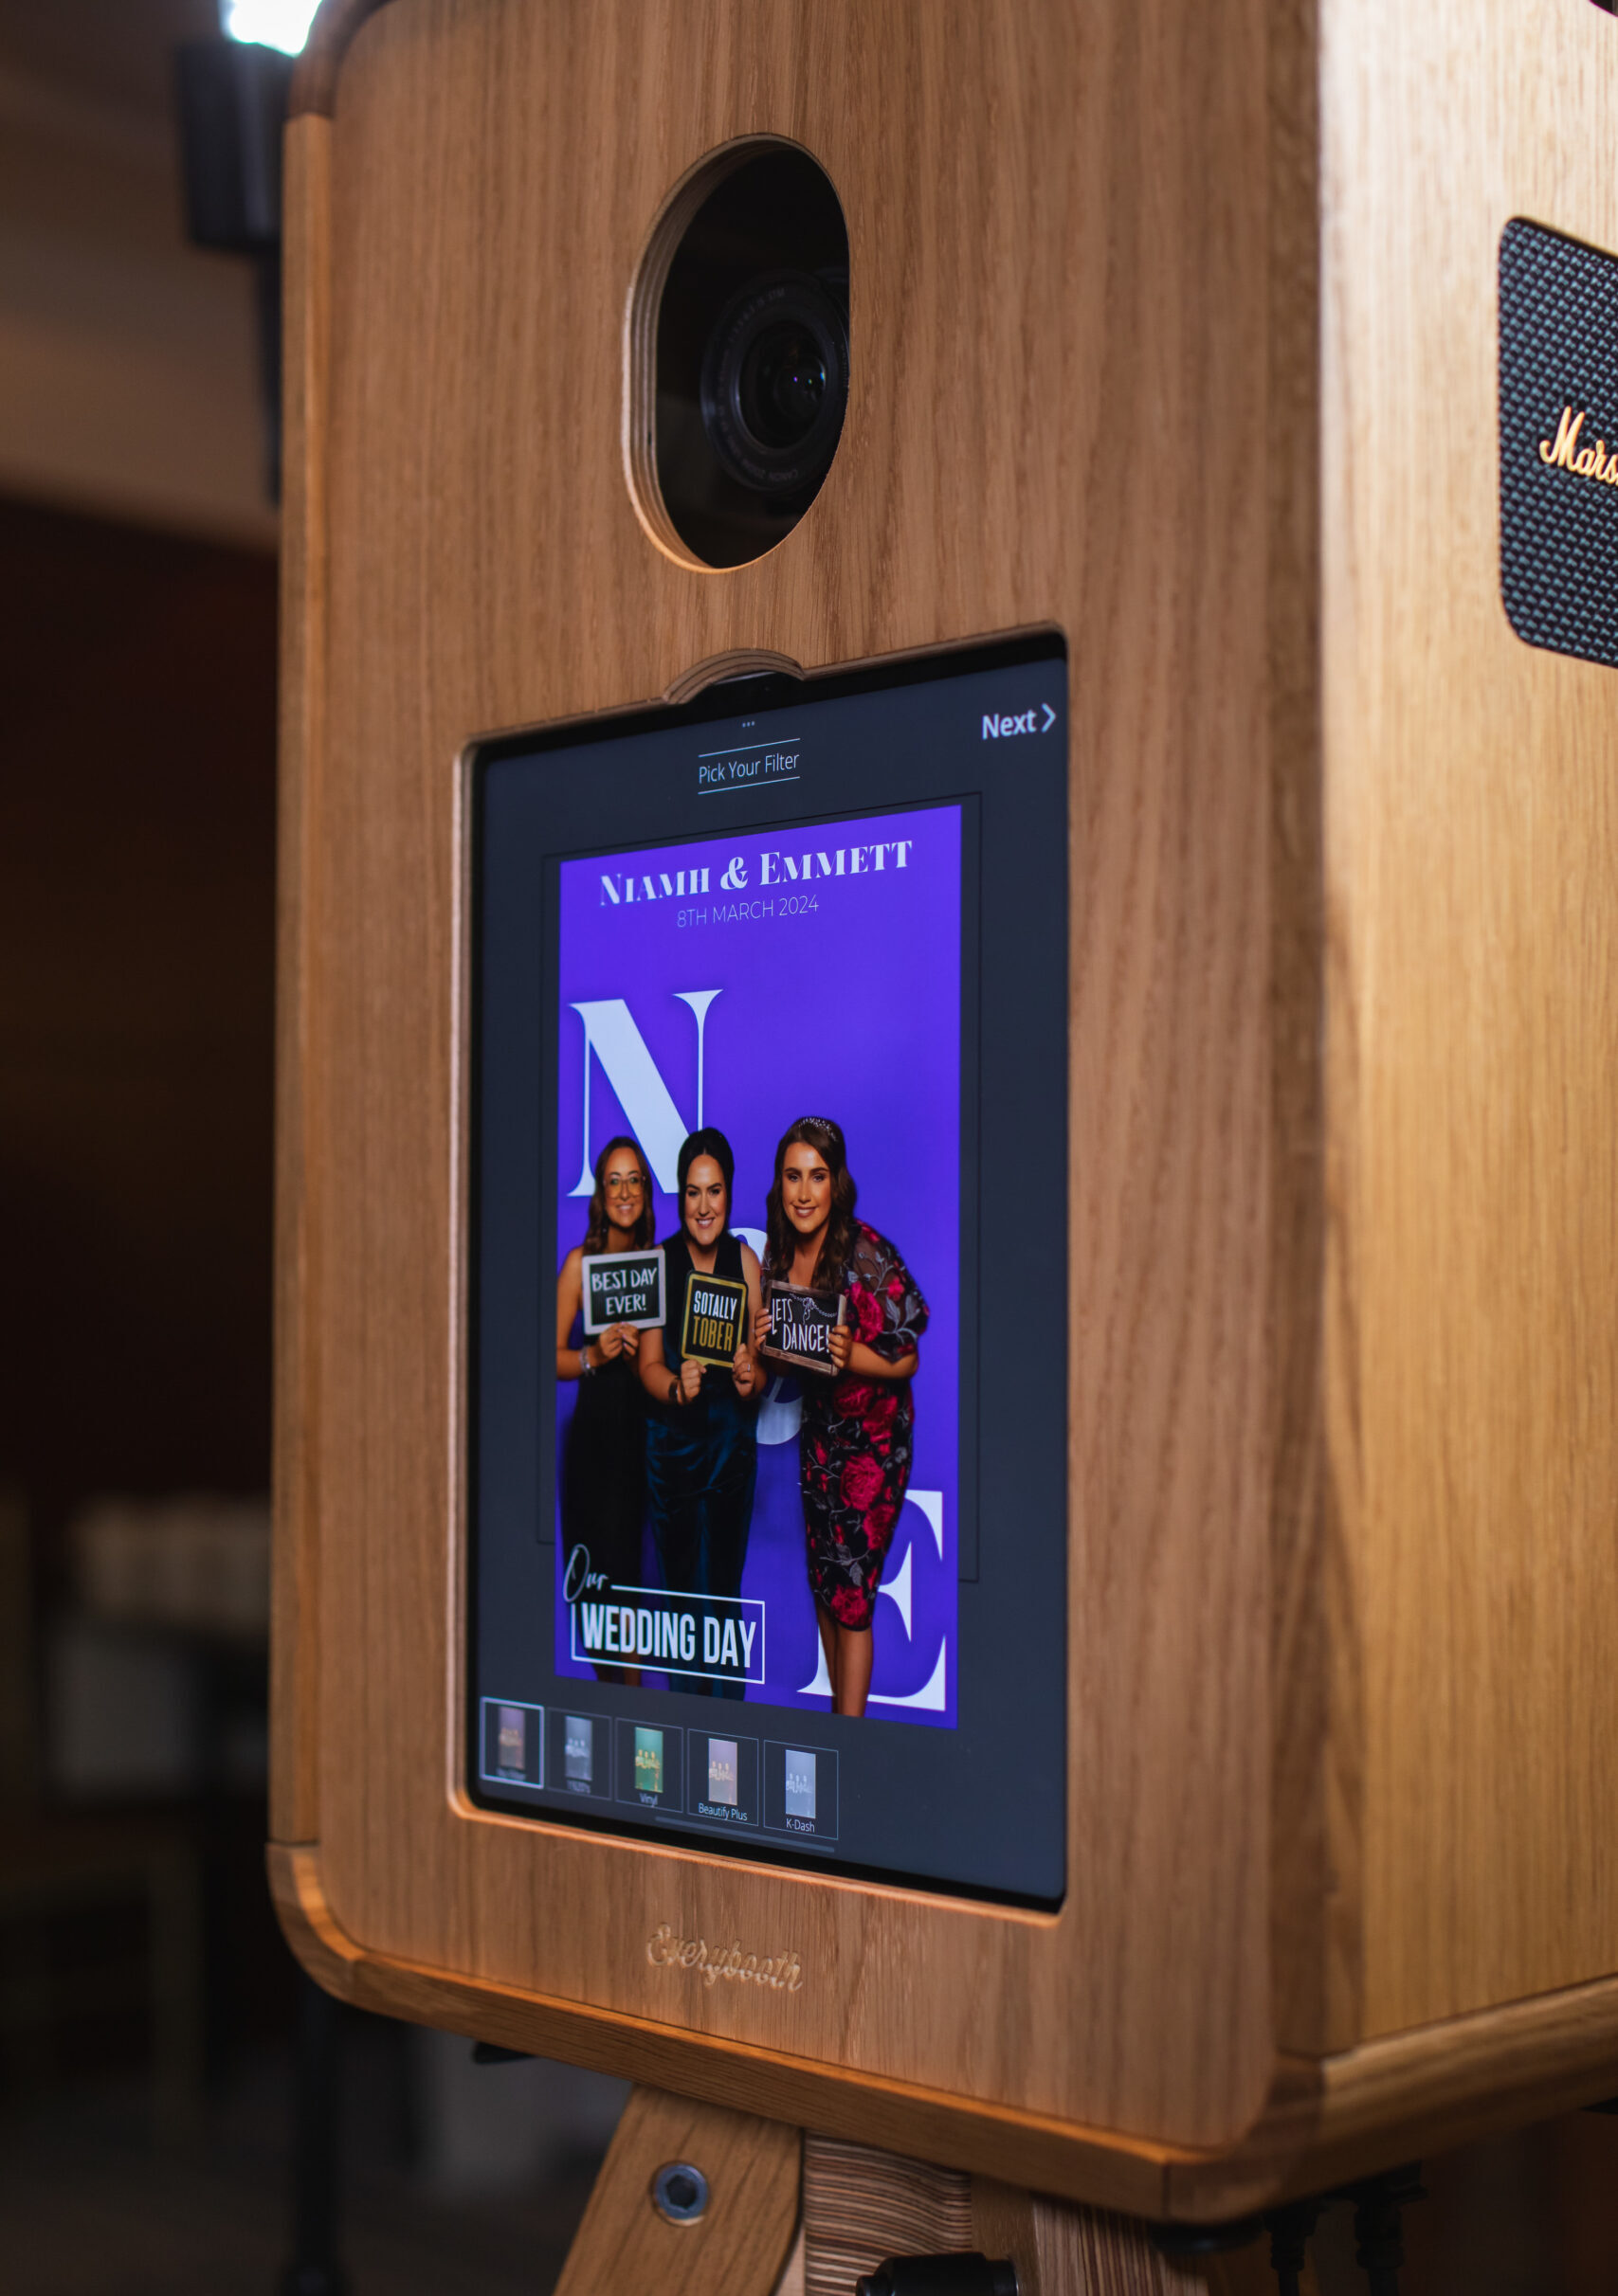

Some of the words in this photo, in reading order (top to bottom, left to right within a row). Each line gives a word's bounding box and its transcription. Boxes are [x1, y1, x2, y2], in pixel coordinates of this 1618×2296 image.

[1539, 406, 1618, 486] Mars
[982, 709, 1037, 739] Next
[699, 765, 725, 785] Pick
[729, 758, 760, 779] Your
[764, 752, 800, 772] Filter
[719, 857, 748, 890] &
[677, 910, 707, 928] 8TH
[712, 902, 774, 923] MARCH
[780, 895, 819, 915] 2024
[591, 1272, 627, 1293] BEST
[630, 1267, 658, 1288] DAY
[605, 1293, 647, 1316] EVER!
[694, 1291, 737, 1318] SOTALLY
[692, 1316, 734, 1352] TOBER
[782, 1325, 831, 1355] DANCE!
[563, 1544, 608, 1602] Our
[582, 1602, 696, 1661] WEDDING
[703, 1616, 757, 1668] DAY
[699, 1802, 729, 1820] Beautify
[730, 1808, 748, 1821] Plus
[786, 1817, 816, 1834] K-Dash
